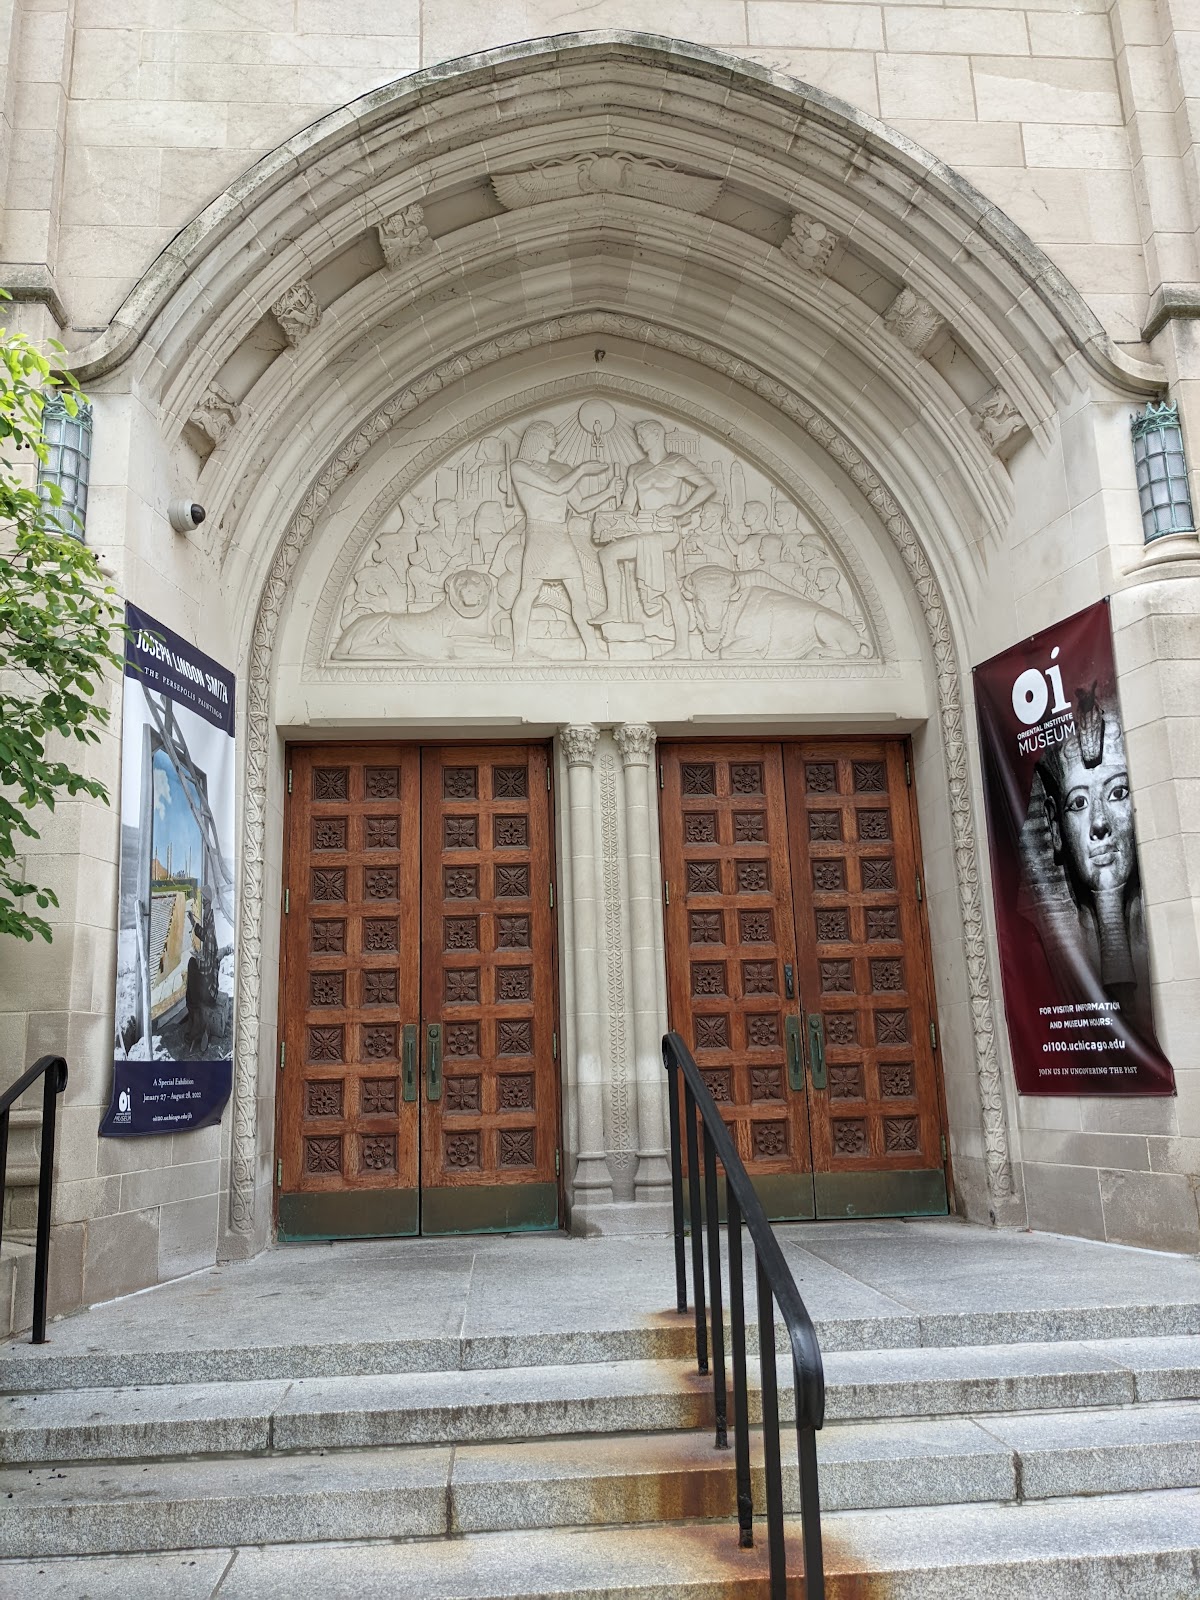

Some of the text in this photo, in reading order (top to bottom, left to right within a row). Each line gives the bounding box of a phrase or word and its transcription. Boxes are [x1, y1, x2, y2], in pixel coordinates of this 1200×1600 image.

[136, 629, 228, 704] JOSEPH LINDON SMITH
[144, 666, 222, 719] THE PERSEPOLIS PAINTINGS
[1017, 712, 1073, 740] ORIENTAL INSTITUTE
[1018, 721, 1076, 757] MUSEUM
[1039, 1002, 1120, 1015] FOR VISITOR INFORMATION
[1050, 1017, 1113, 1029] AND MUSEUM HOURS:
[1043, 1039, 1125, 1051] oi100.uchicago.edu
[1039, 1067, 1052, 1077] JOIN
[1062, 1067, 1069, 1075] IN
[1070, 1066, 1108, 1075] UNCOVERING
[1108, 1066, 1123, 1074] THE
[1123, 1066, 1138, 1074] PAST
[153, 1078, 158, 1086] A
[158, 1077, 174, 1089] Special
[143, 1093, 159, 1103] January
[170, 1092, 184, 1101] August
